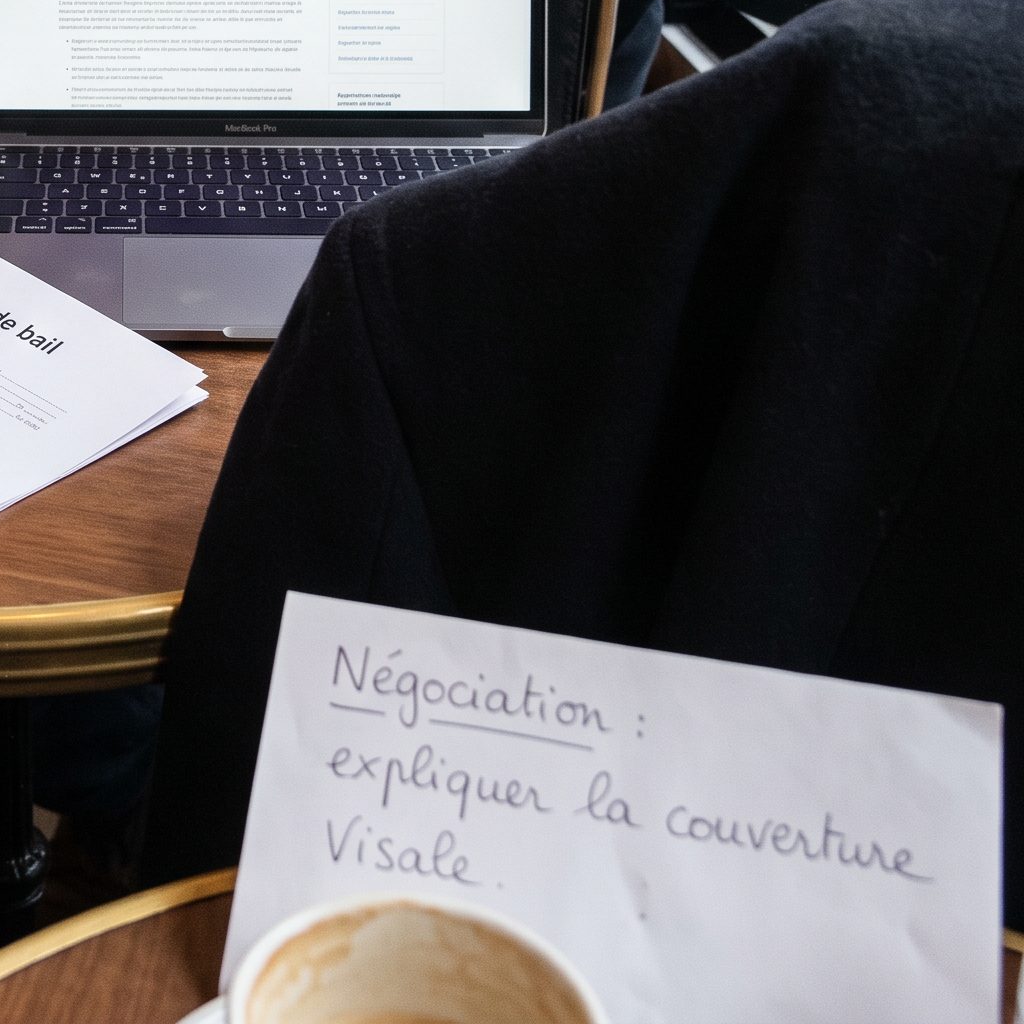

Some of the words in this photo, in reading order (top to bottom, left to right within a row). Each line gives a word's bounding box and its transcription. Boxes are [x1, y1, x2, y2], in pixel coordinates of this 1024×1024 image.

[263, 124, 277, 133] Pro
[16, 324, 64, 355] bail
[331, 643, 613, 734] Négociation
[328, 744, 554, 819] expliquer
[581, 770, 643, 829] la
[665, 803, 937, 884] couverture
